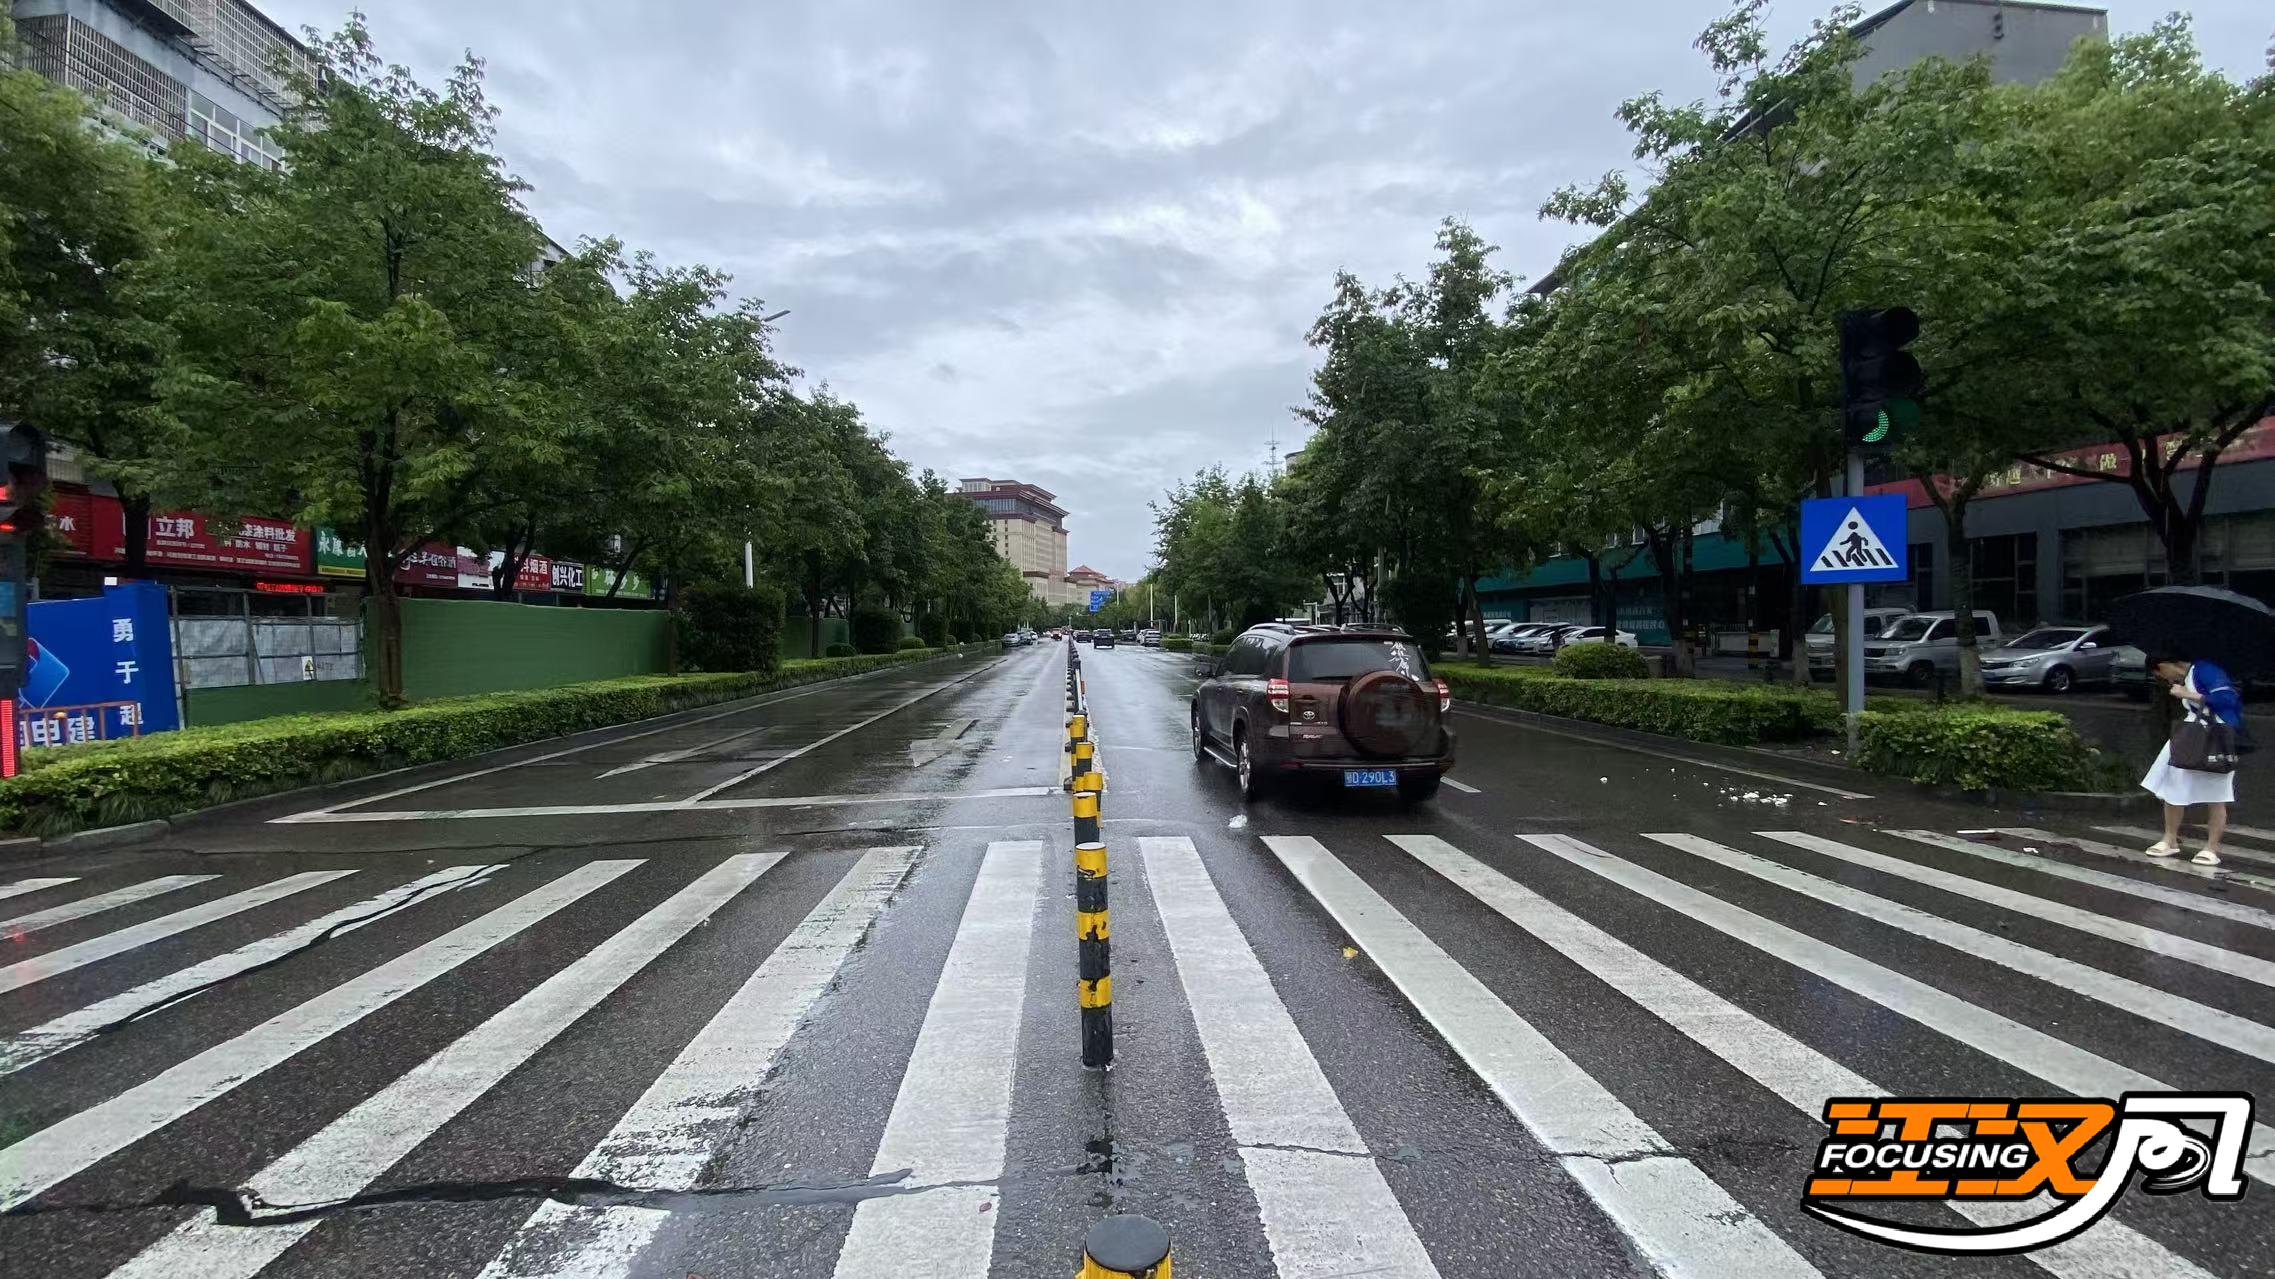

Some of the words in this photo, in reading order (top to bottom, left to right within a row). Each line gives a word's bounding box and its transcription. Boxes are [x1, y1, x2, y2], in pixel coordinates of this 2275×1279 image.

[155, 516, 194, 539] 立邦
[552, 564, 583, 588] 创兴化工
